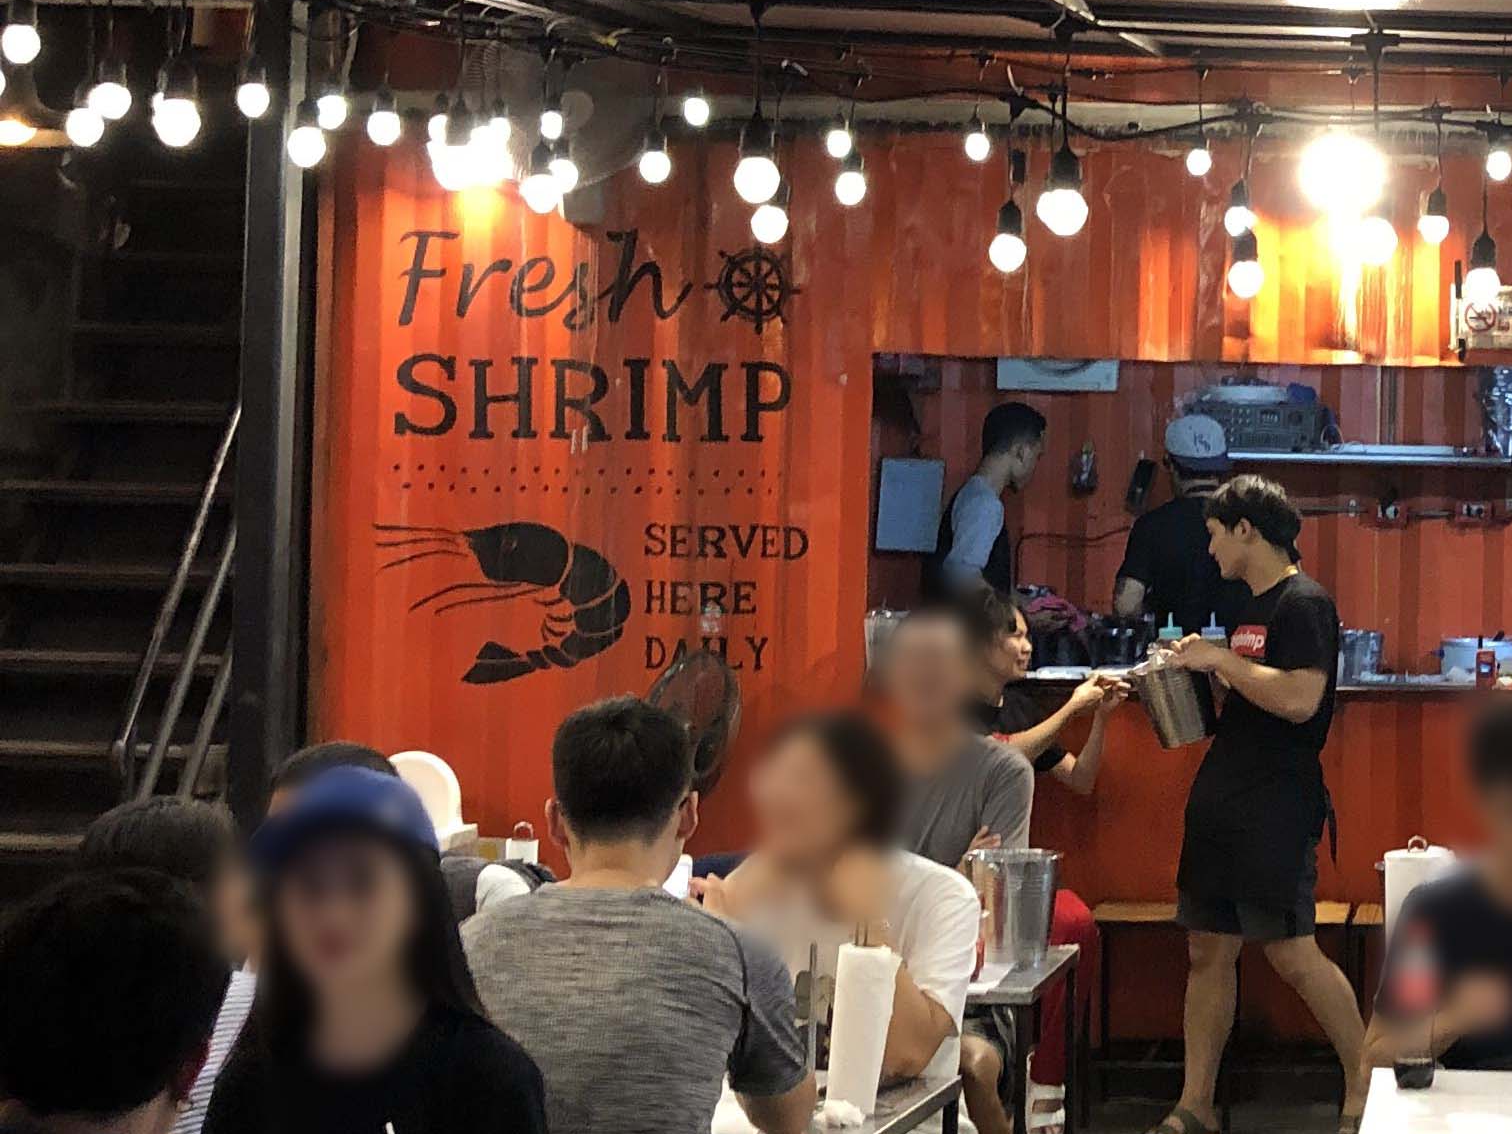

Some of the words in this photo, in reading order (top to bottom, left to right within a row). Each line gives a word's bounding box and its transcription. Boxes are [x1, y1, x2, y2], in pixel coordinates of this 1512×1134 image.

[398, 229, 694, 332] Fresh
[393, 353, 793, 444] SHRIMP
[643, 522, 809, 561] SERVED
[644, 579, 758, 616] HERE
